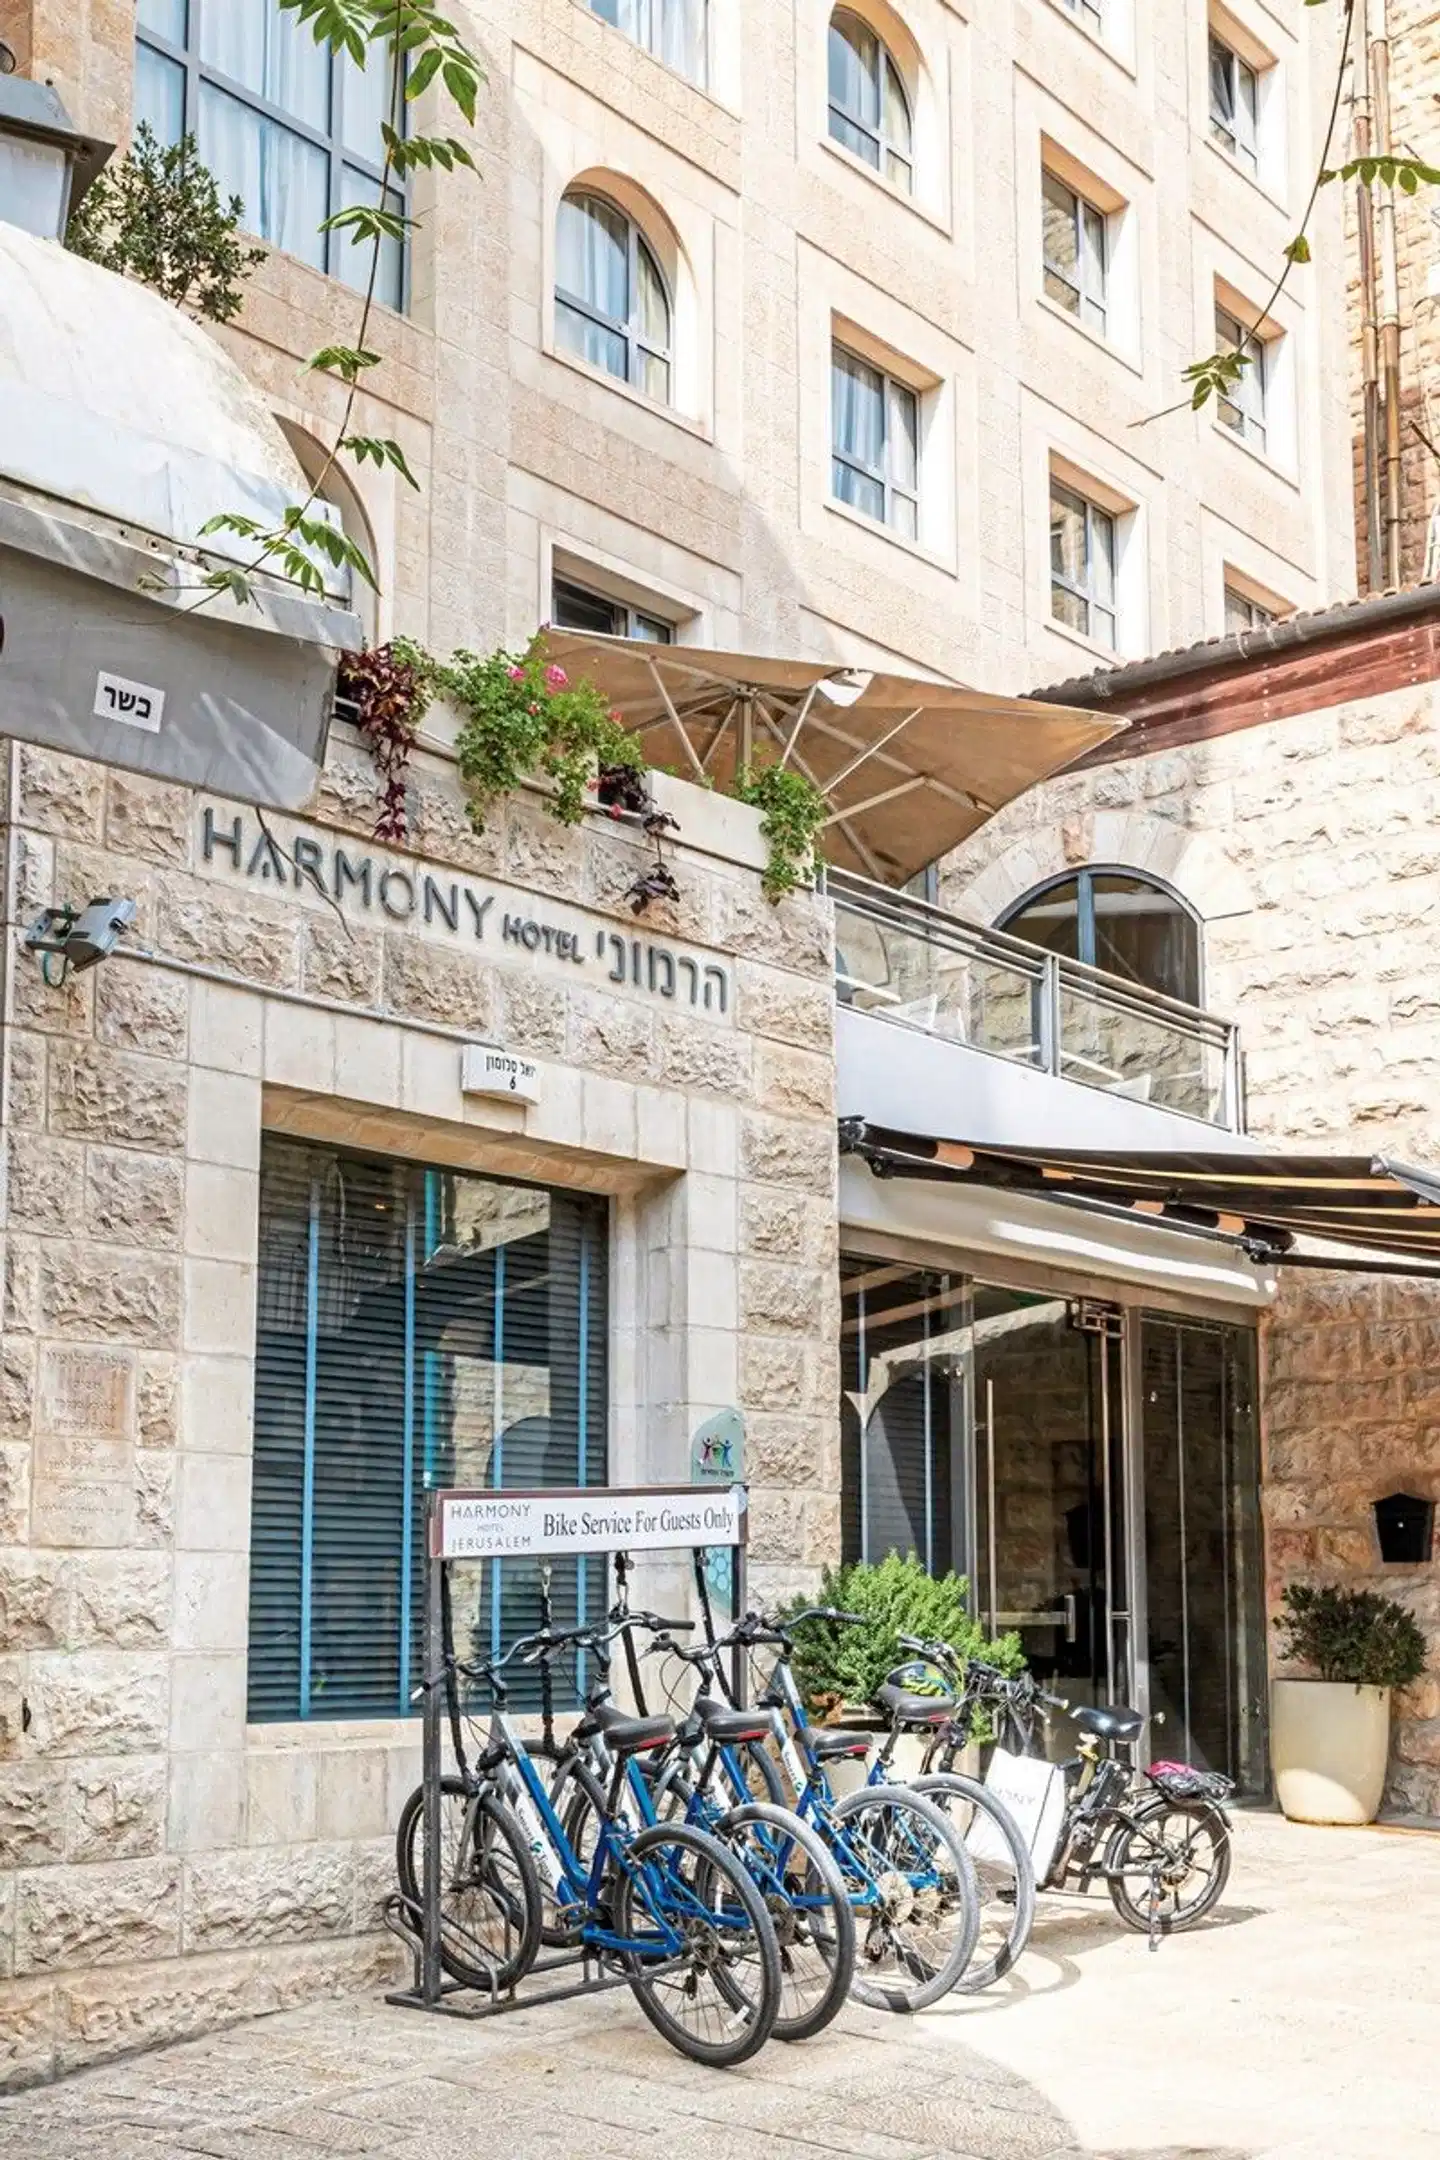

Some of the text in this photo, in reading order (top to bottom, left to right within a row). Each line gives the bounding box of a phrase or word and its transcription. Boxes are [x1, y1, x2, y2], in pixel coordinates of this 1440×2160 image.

[103, 685, 151, 719] כשר
[203, 807, 585, 965] HARMONY HOTEL
[596, 930, 728, 1014] הרמוני
[486, 1055, 518, 1073] סלומון
[509, 1075, 517, 1090] 6
[451, 1504, 531, 1519] HARMONY
[543, 1506, 734, 1537] Bike Service For Guests Only
[451, 1535, 531, 1553] JERUSALEM
